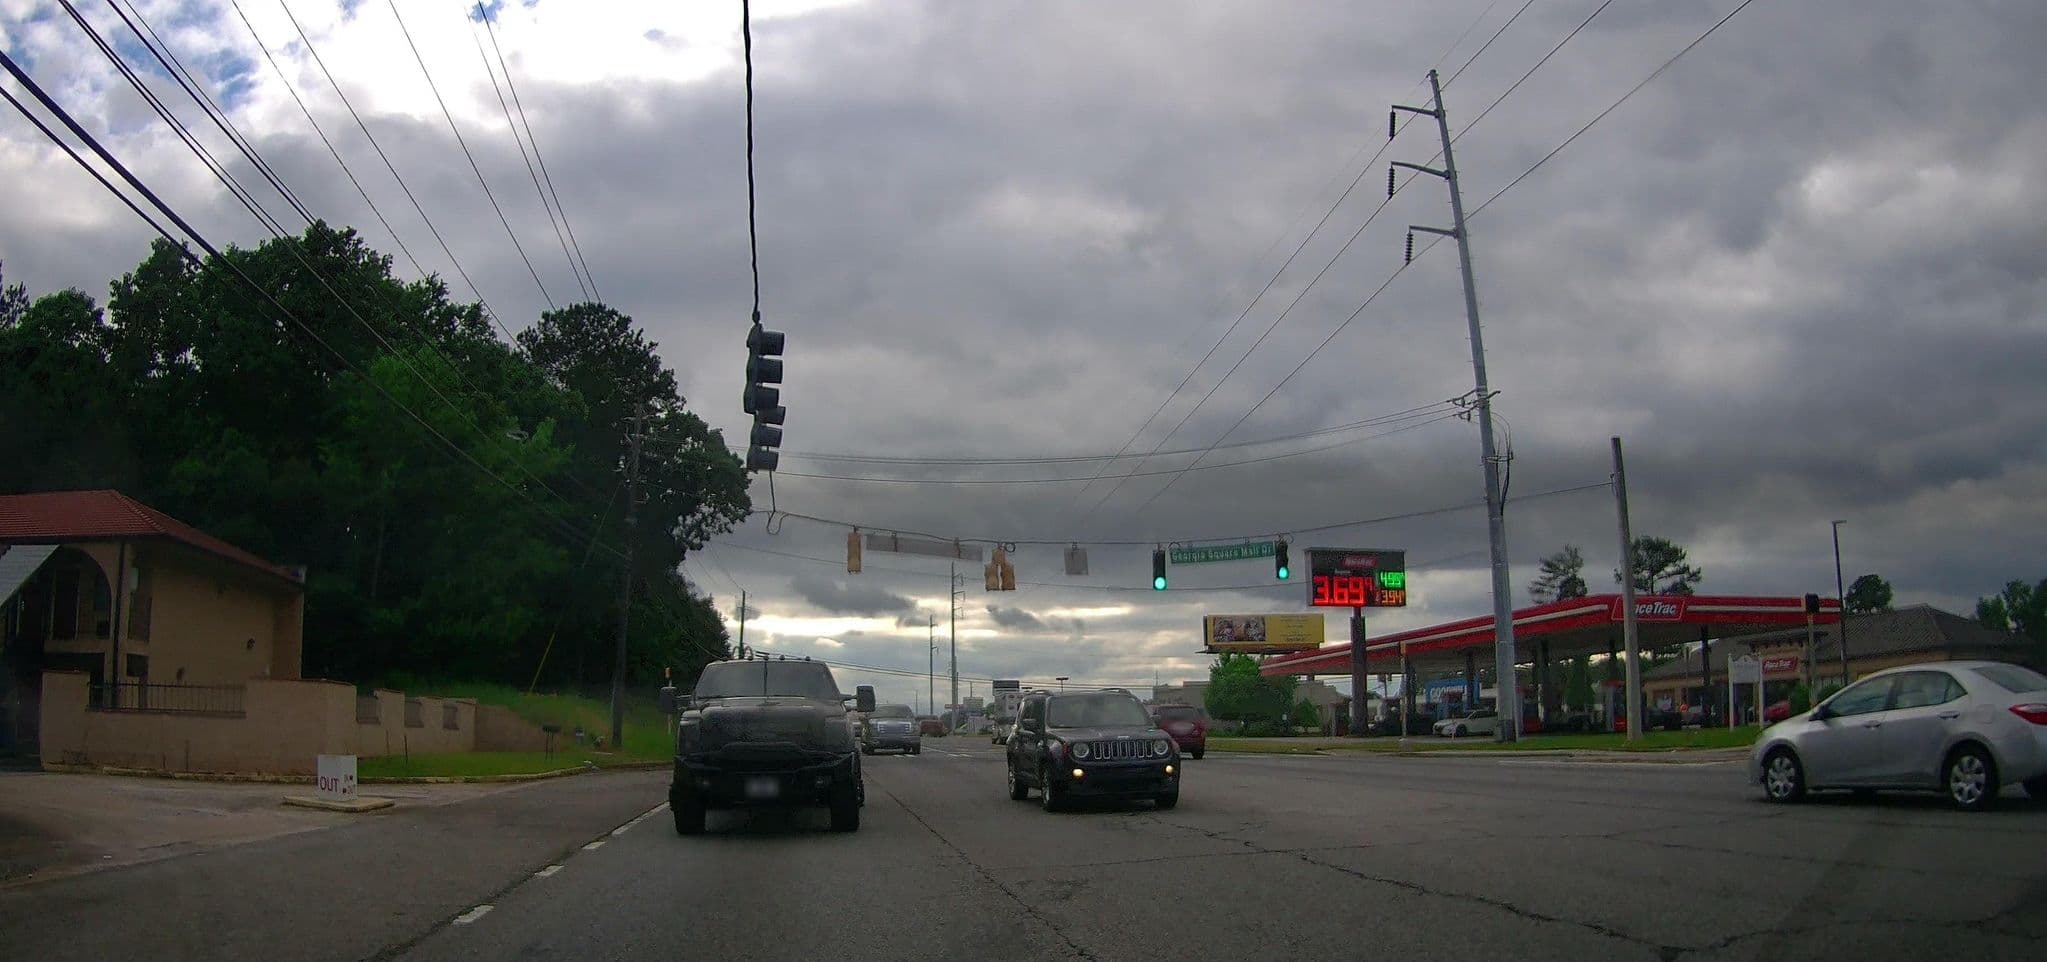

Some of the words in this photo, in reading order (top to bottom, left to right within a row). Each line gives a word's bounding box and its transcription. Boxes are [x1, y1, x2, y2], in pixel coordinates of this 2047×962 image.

[1172, 550, 1205, 562] Georgia
[1208, 548, 1238, 560] Square
[1241, 547, 1259, 557] Mall
[1262, 545, 1272, 554] Dr
[320, 776, 340, 793] OUT
